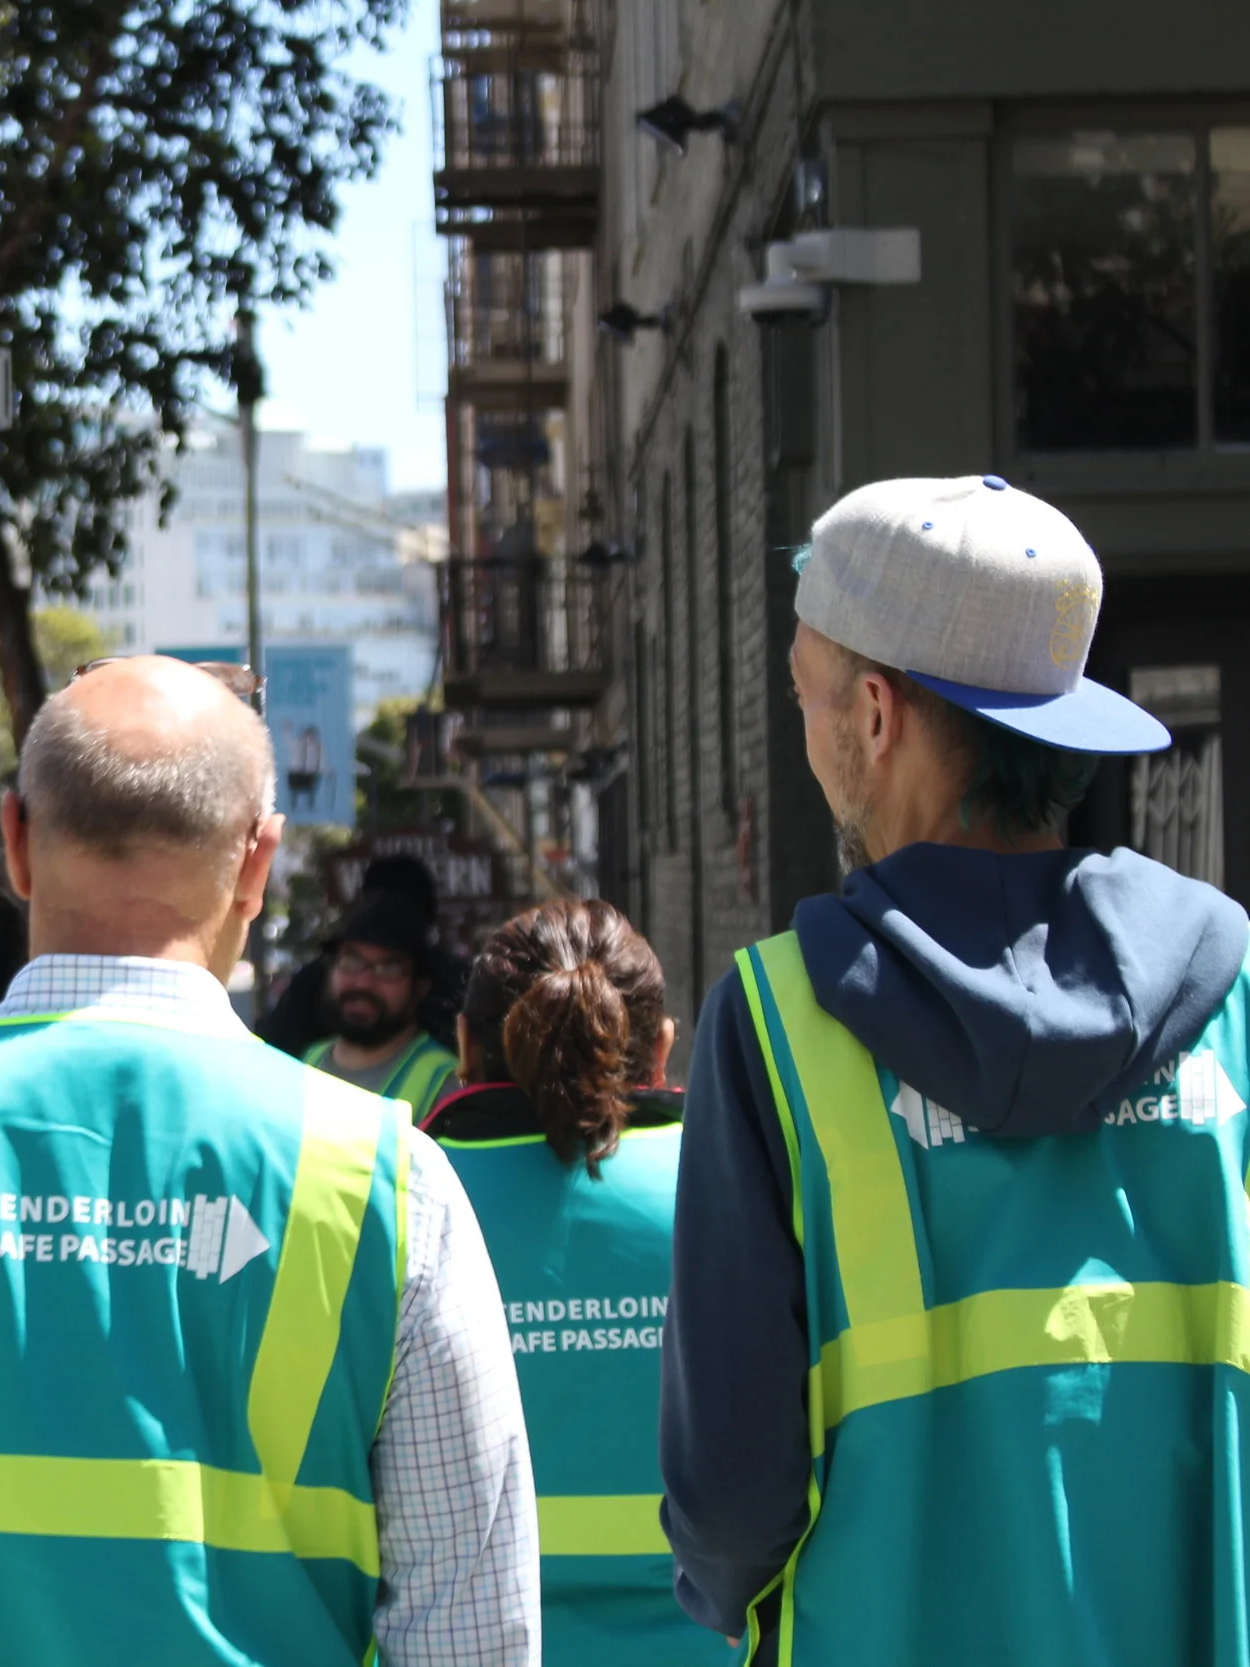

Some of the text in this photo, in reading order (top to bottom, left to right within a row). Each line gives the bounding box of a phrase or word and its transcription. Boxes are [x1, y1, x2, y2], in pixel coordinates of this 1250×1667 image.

[61, 1235, 188, 1266] PASSAGE
[503, 1296, 668, 1323] ENDERLOIN
[512, 1331, 556, 1353] AFE
